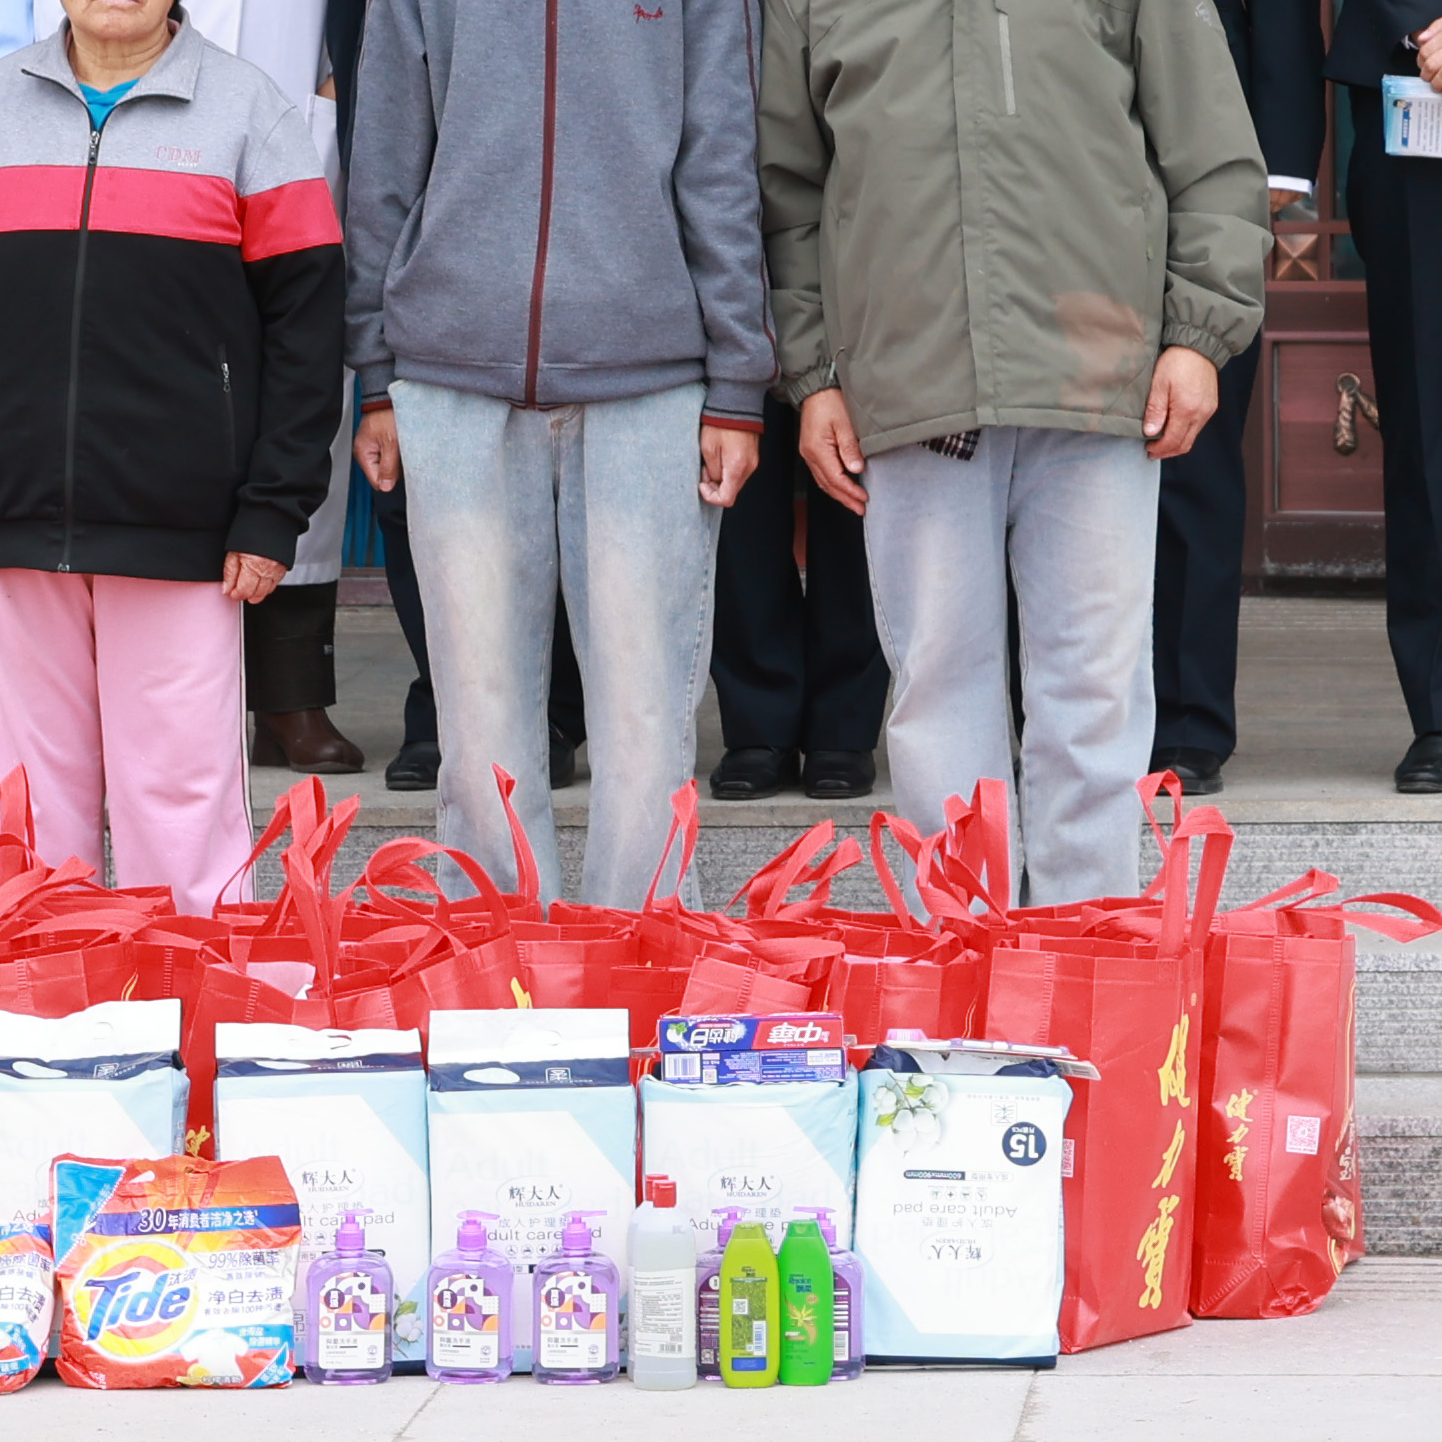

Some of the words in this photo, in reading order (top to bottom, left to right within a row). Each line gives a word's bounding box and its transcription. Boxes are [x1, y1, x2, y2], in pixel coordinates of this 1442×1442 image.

[1009, 1134, 1039, 1159] 15
[893, 1203, 923, 1216] pad
[930, 1204, 967, 1214] care
[973, 1204, 1018, 1218] Adult
[364, 1211, 395, 1228] pad
[690, 1218, 718, 1231] Adu
[487, 1229, 520, 1241] dult
[526, 1229, 562, 1241] care
[208, 1287, 284, 1305] 净白去渍
[83, 1271, 191, 1341] Tide
